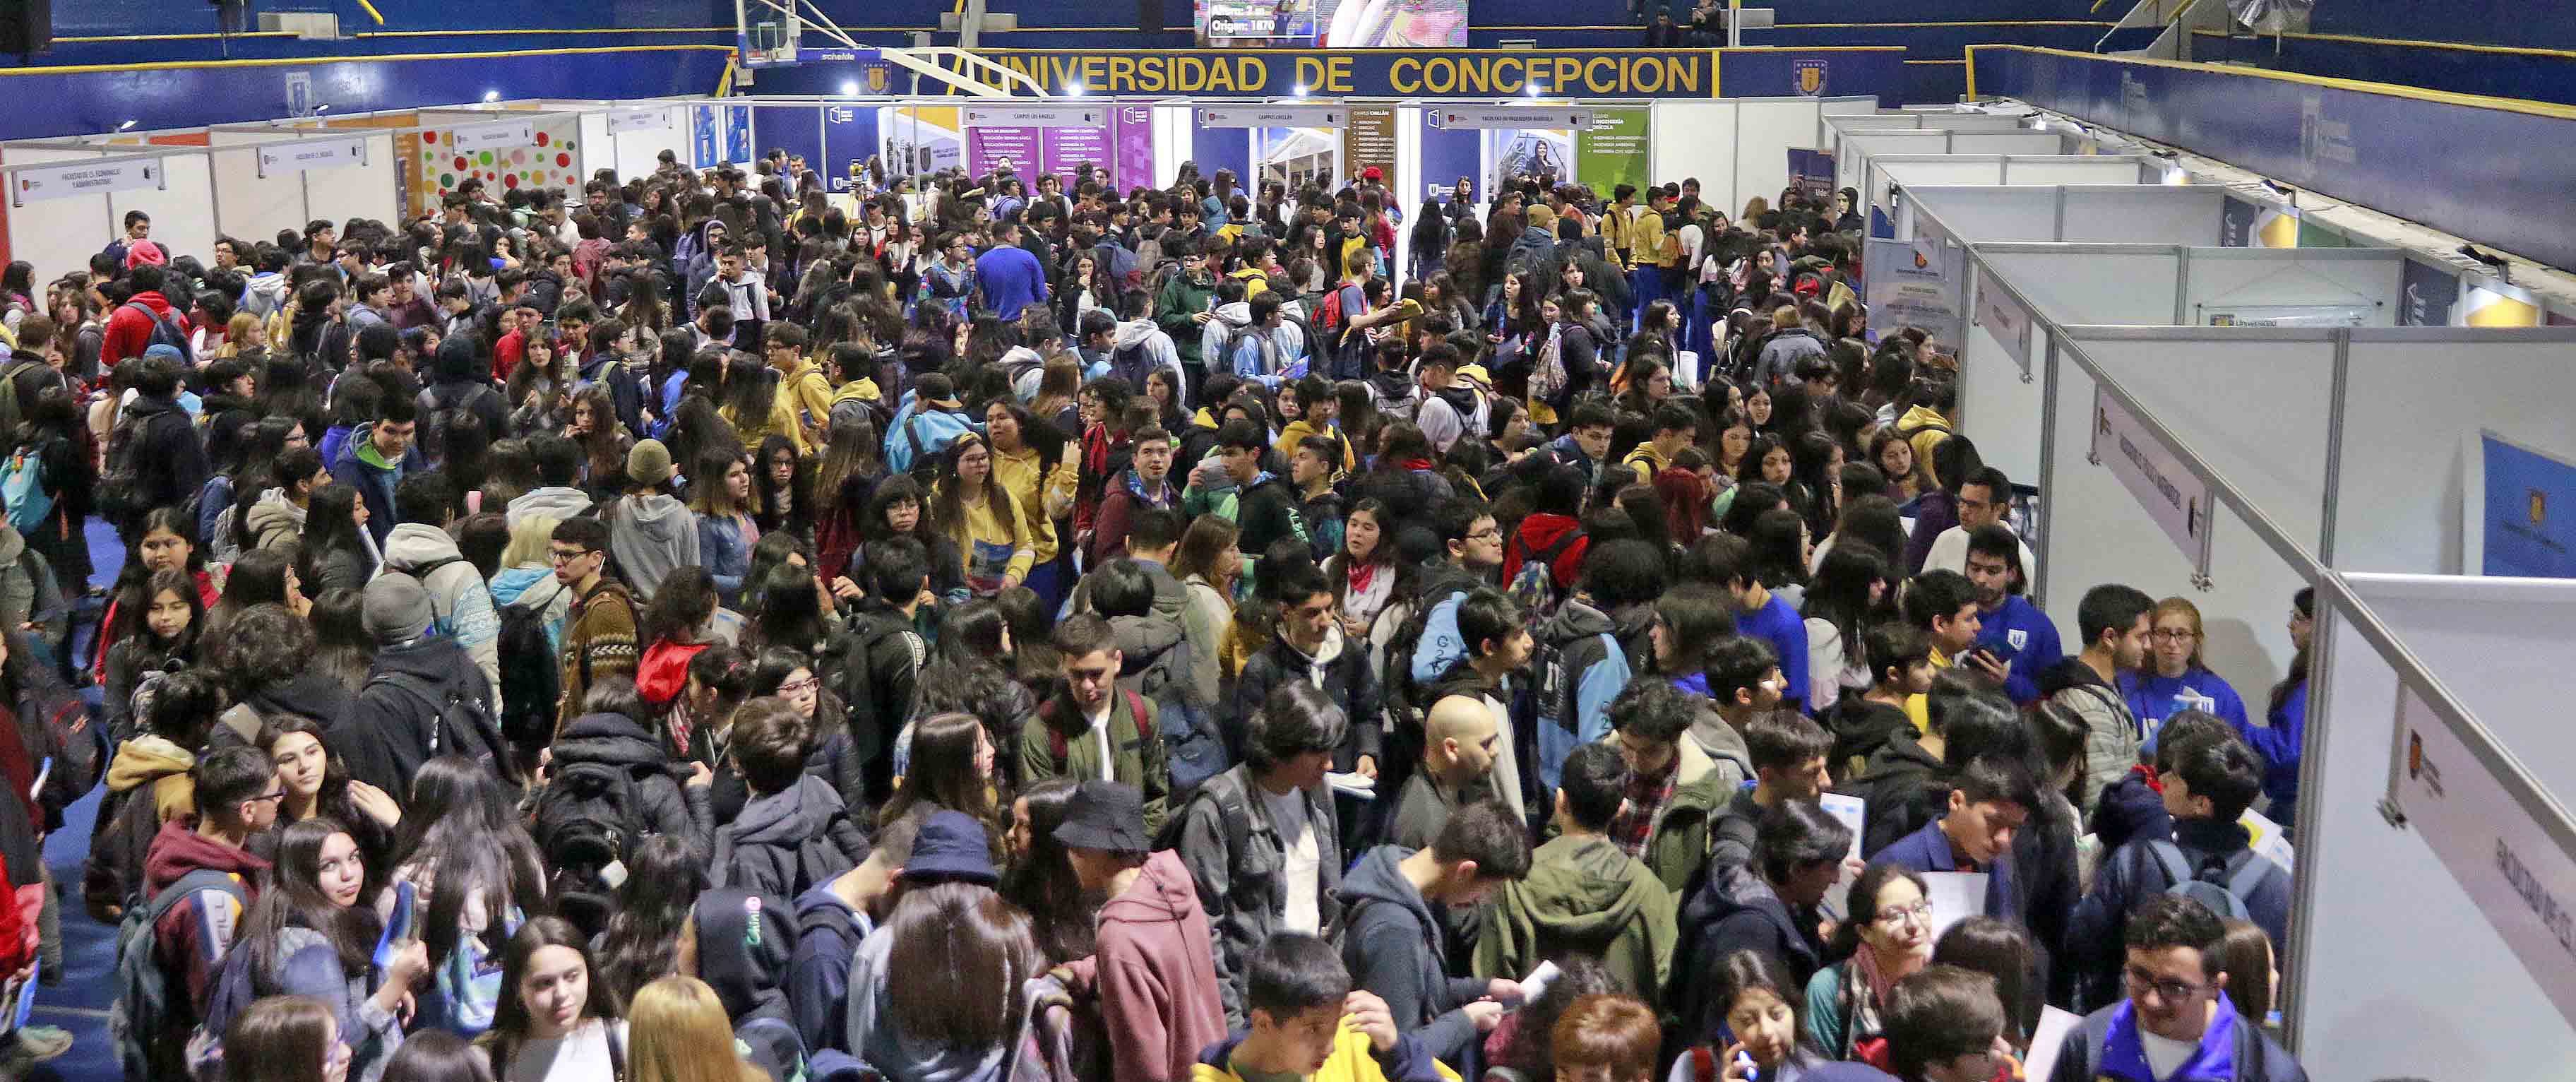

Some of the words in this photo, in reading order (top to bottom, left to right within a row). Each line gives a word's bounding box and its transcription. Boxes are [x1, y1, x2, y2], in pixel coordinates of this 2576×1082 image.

[1212, 19, 1248, 34] Origen:
[1252, 20, 1276, 31] 1870
[982, 56, 1267, 92] UNIVERSIDAD
[1296, 57, 1354, 93] DE
[1390, 57, 1698, 93] CONCEPCION
